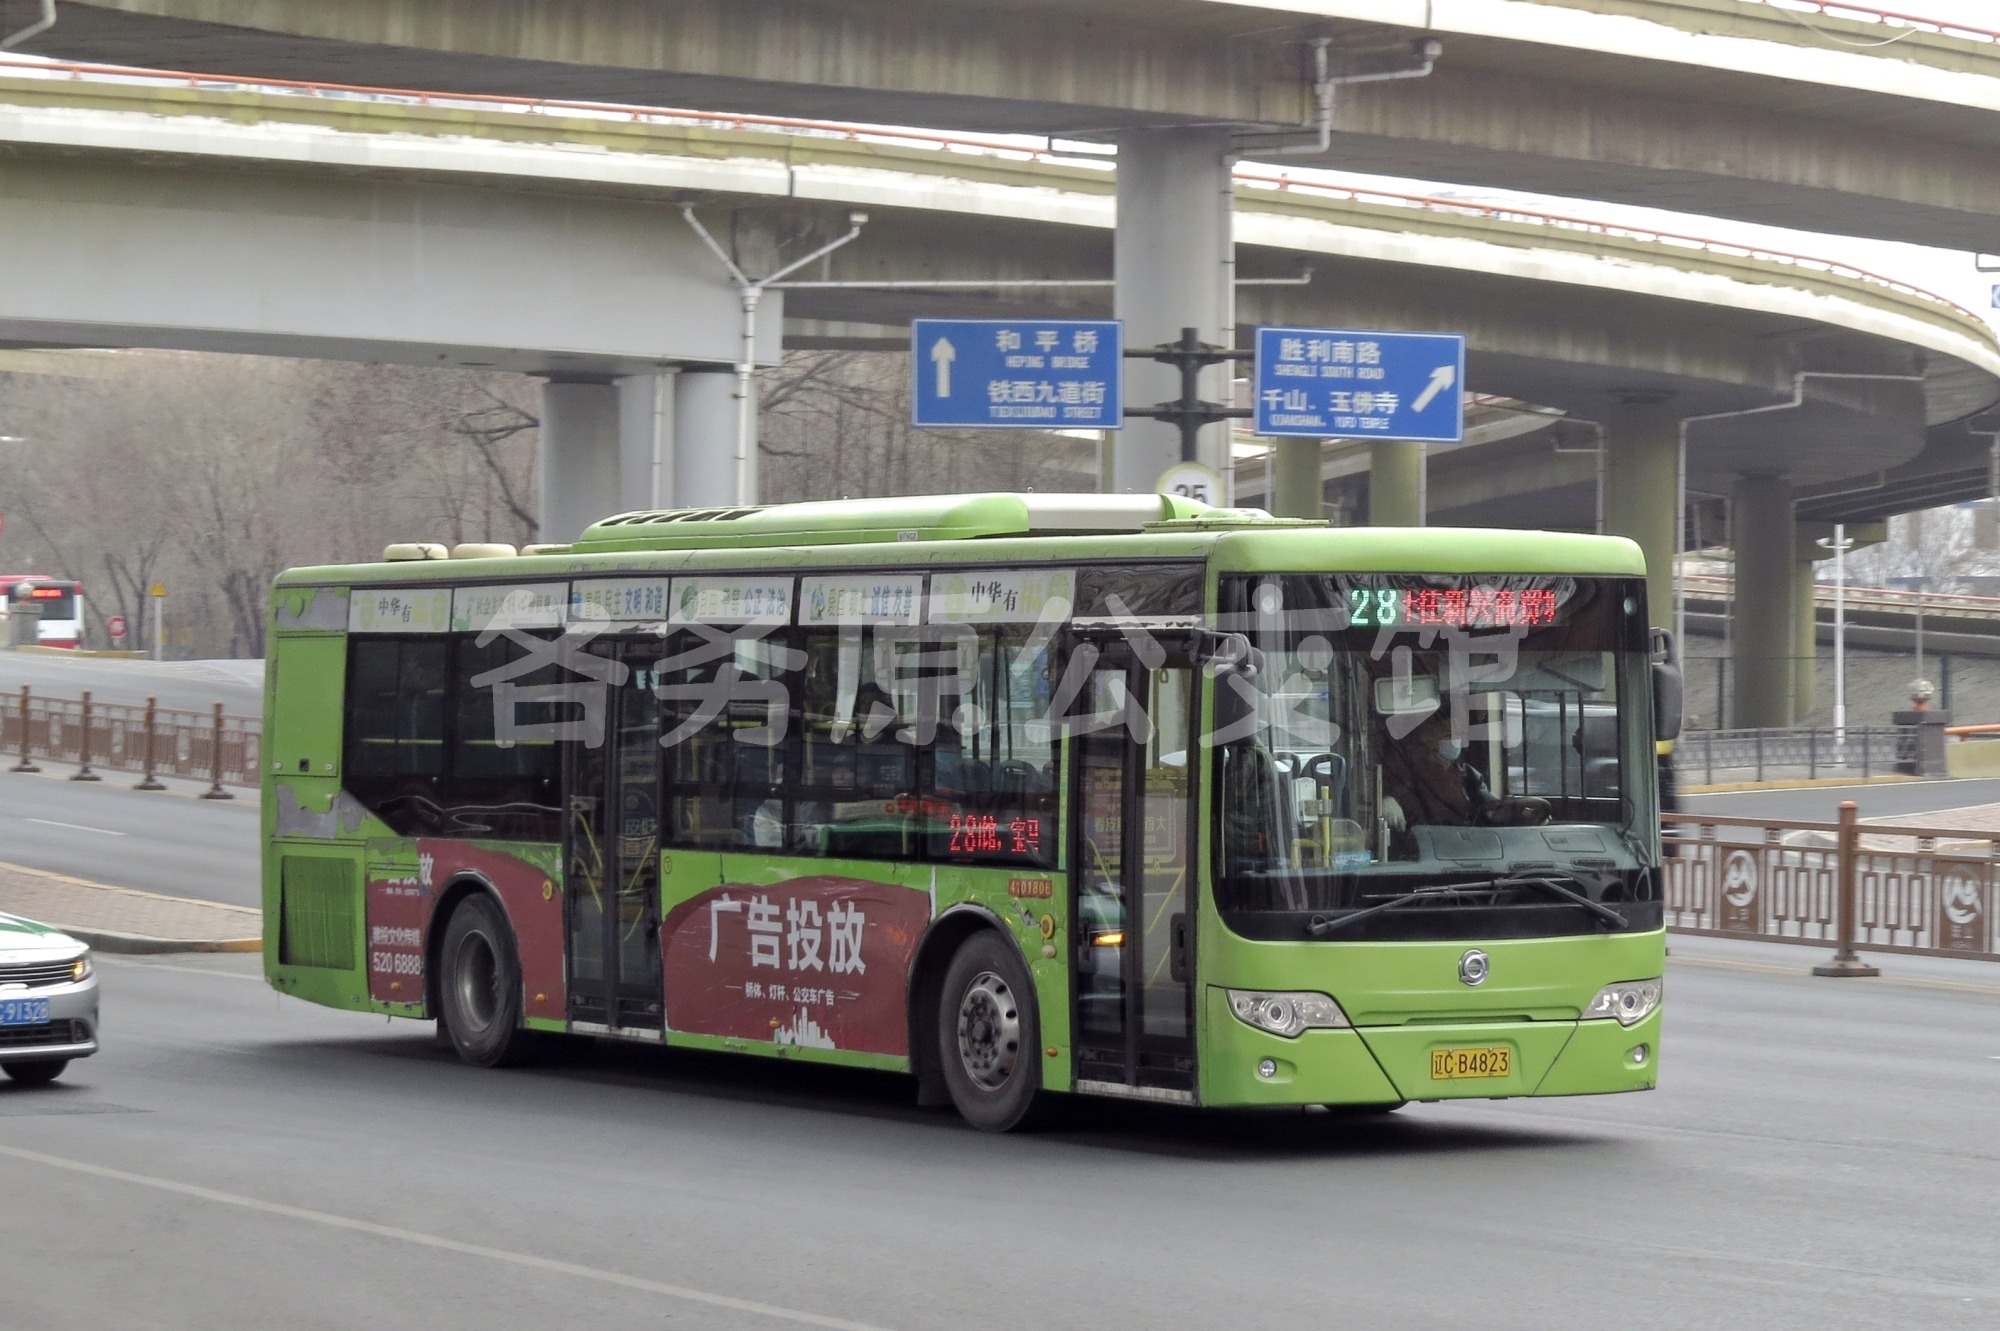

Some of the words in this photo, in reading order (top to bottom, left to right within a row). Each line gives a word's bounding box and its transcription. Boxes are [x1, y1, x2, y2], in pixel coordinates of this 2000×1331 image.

[995, 329, 1099, 353] 和平桥
[1279, 338, 1381, 364] 胜利南路
[988, 380, 1106, 404] 铁西九道街
[1351, 589, 1397, 625] 28
[708, 892, 866, 976] 广告投放
[373, 952, 393, 972] 520
[394, 953, 421, 975] 6888
